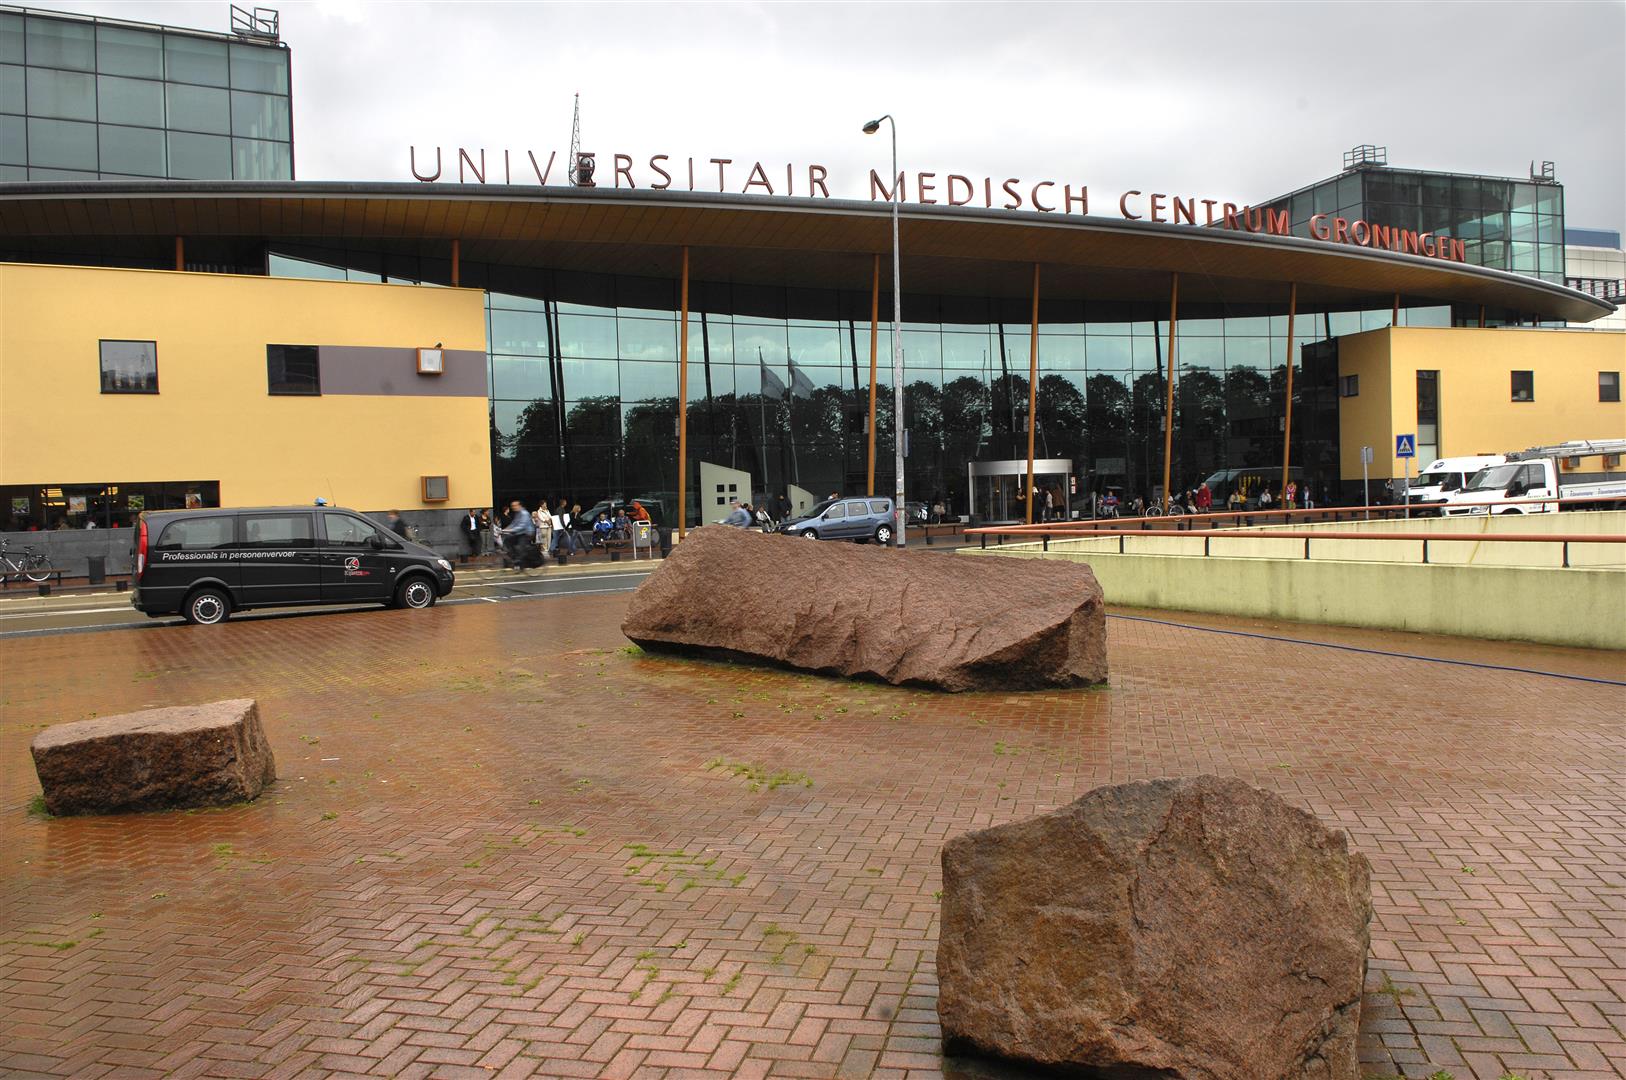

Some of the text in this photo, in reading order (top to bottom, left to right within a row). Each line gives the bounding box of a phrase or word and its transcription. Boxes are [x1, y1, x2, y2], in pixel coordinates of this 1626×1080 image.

[410, 146, 1465, 262] UNIVERSITAIR MEDISCH CENTRUM GRONINGEN
[162, 551, 296, 561] Professionals in personenvervoer
